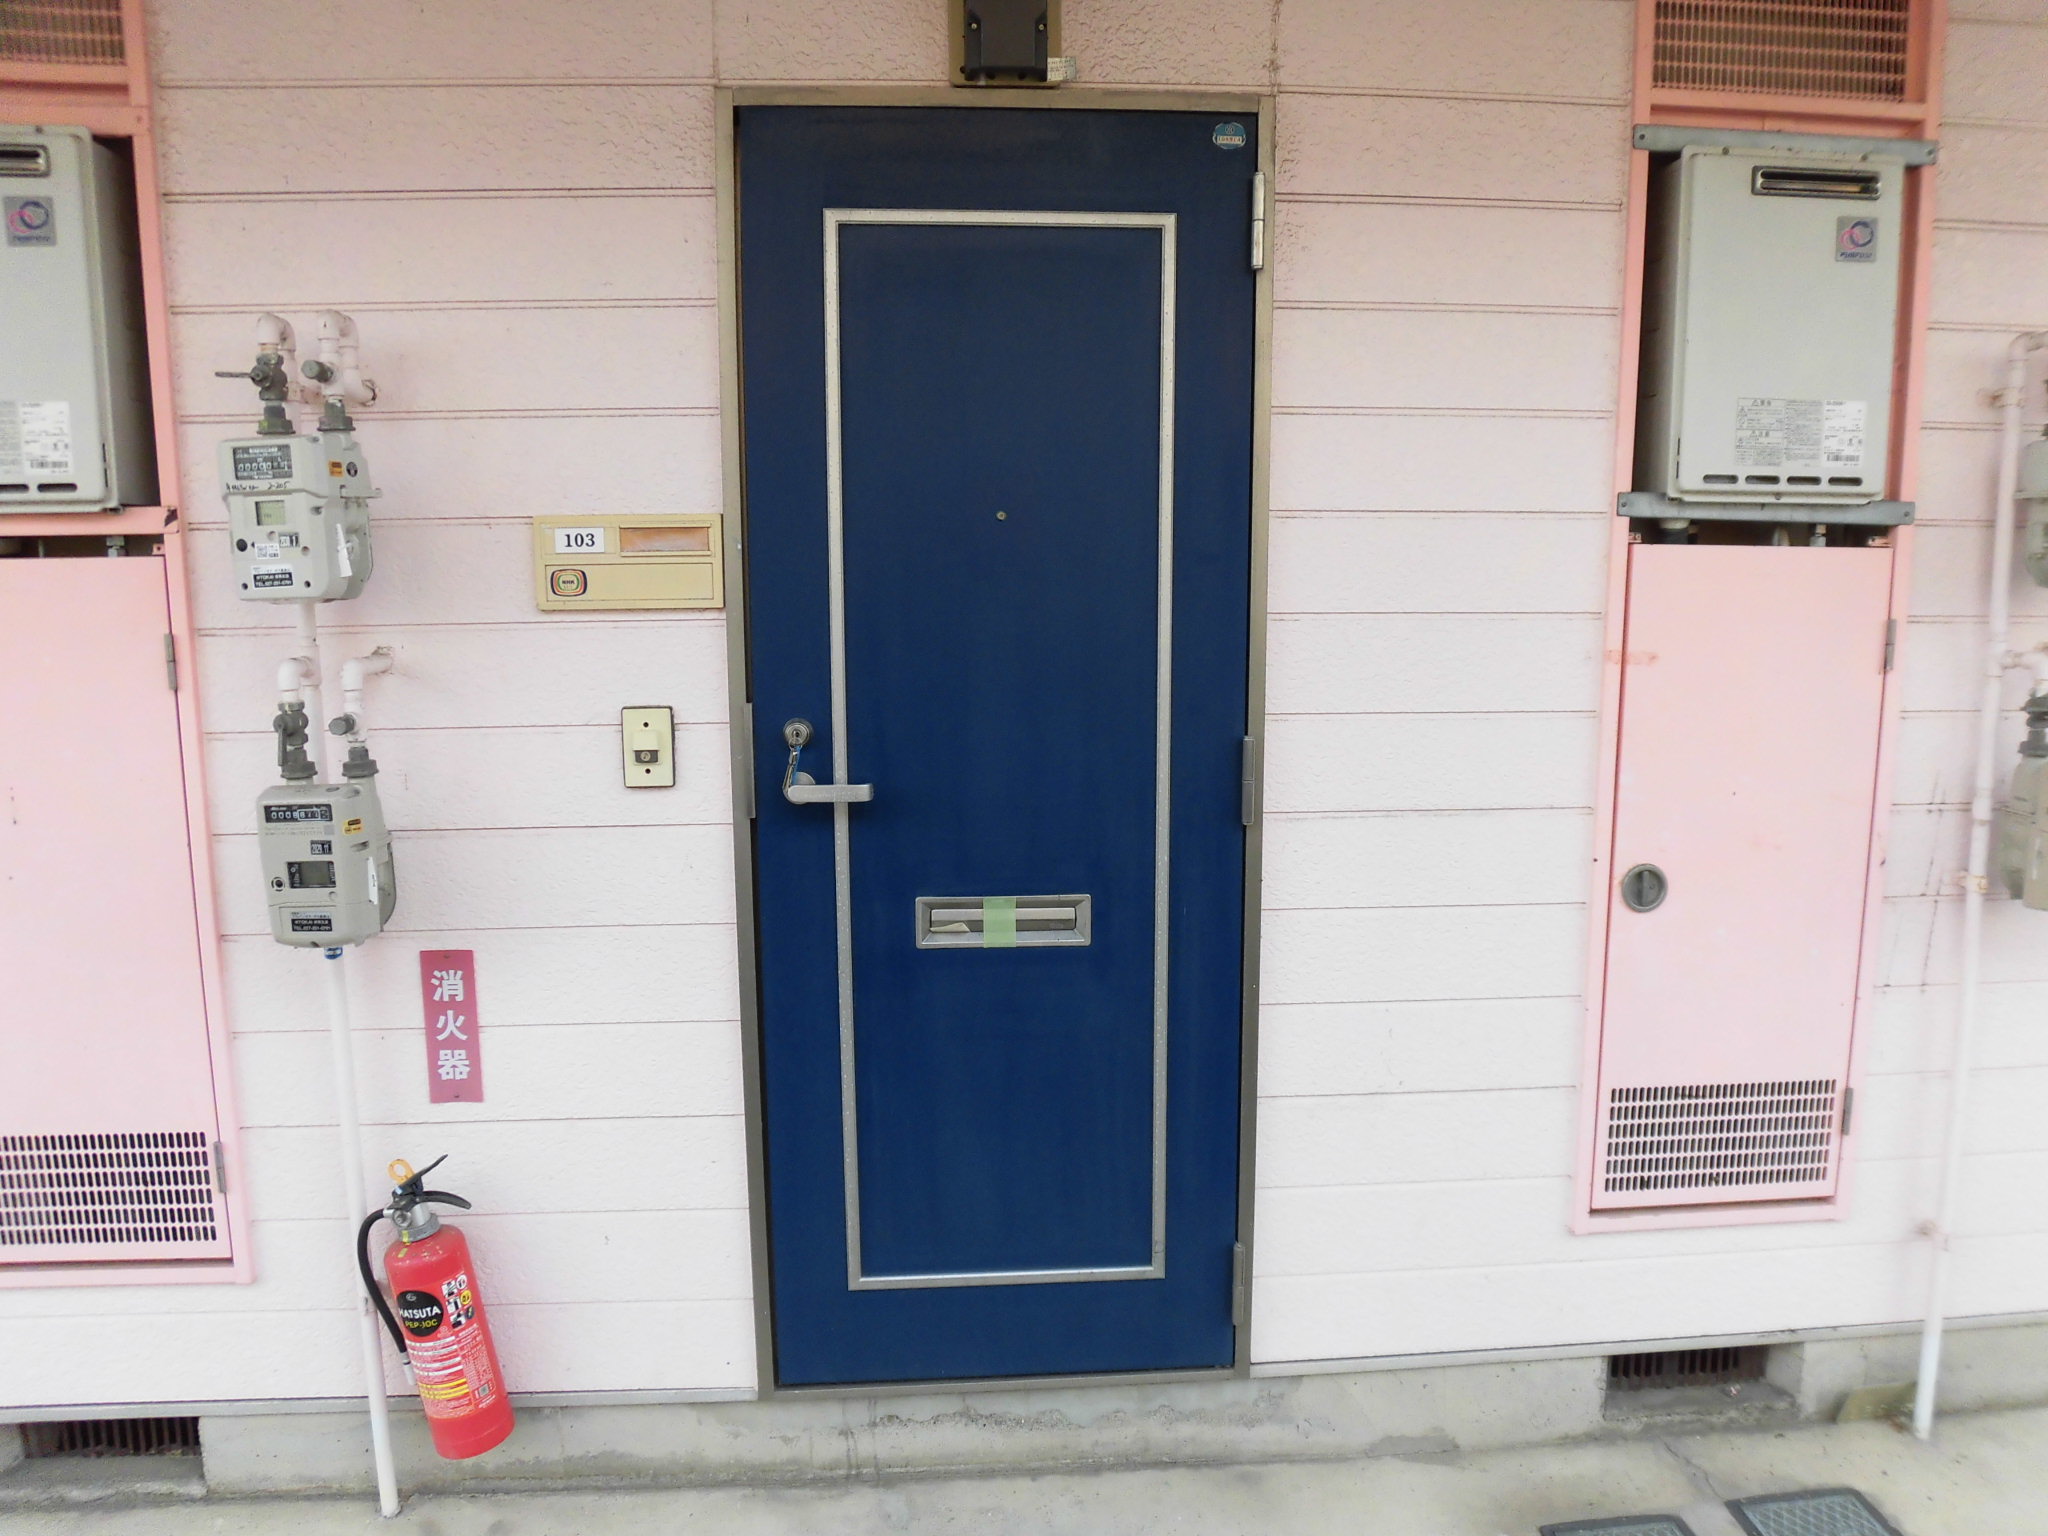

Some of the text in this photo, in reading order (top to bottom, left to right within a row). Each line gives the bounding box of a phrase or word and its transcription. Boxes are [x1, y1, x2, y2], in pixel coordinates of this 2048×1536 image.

[565, 533, 596, 548] 103
[430, 969, 471, 1081] 消火器
